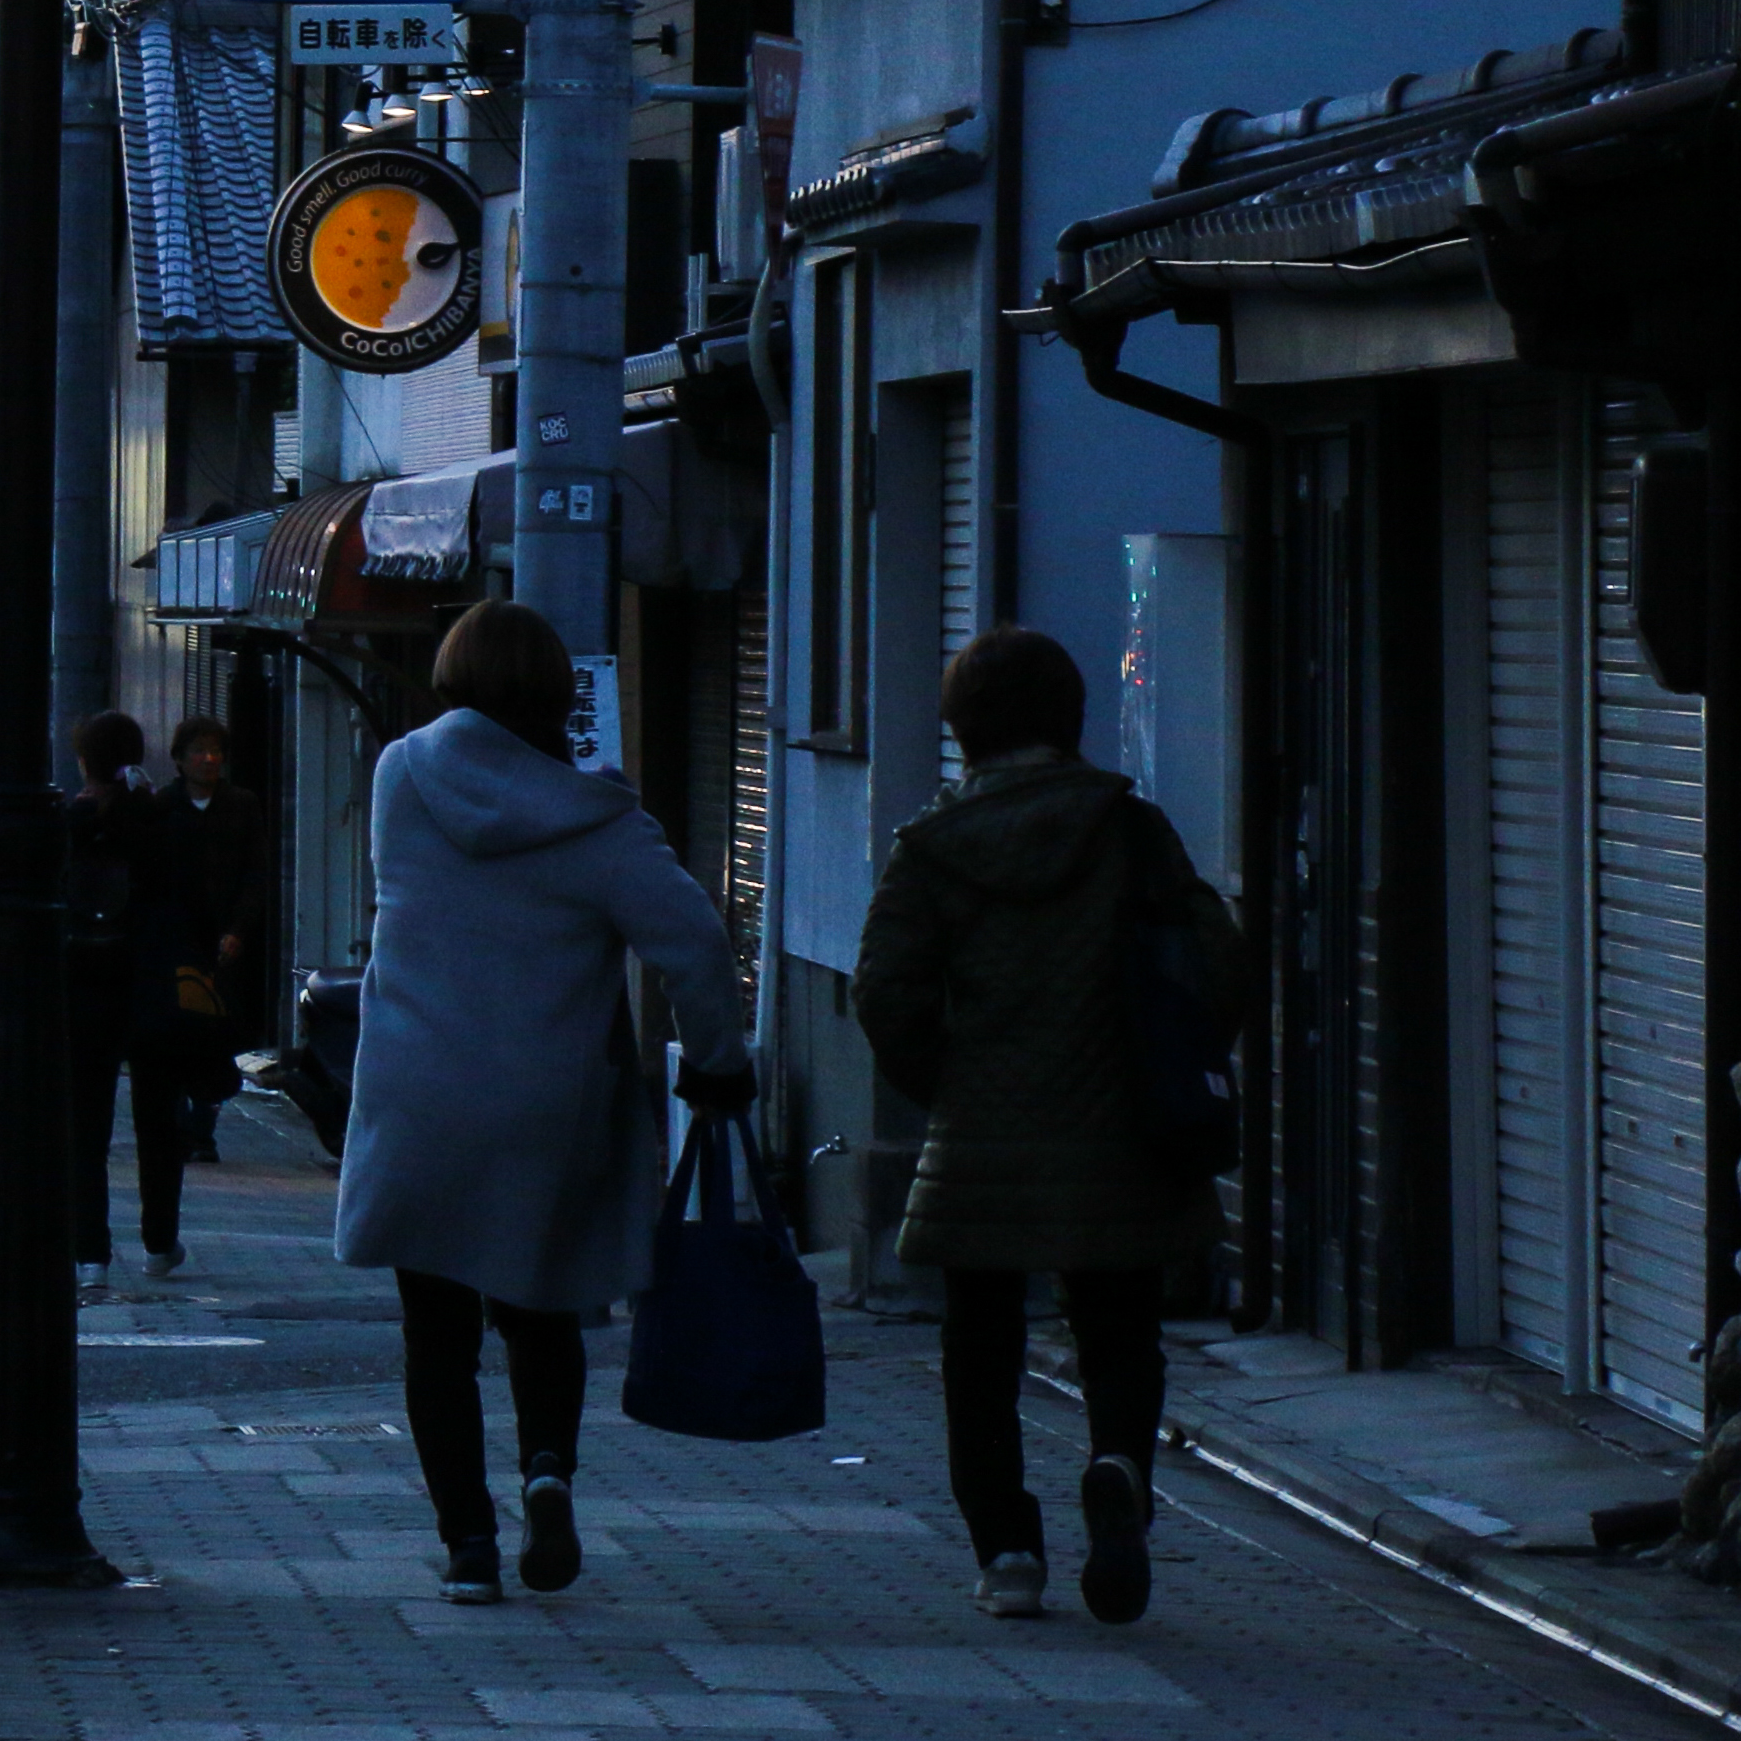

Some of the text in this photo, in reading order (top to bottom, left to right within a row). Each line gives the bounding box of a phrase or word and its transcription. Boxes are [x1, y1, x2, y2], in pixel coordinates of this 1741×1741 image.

[299, 17, 446, 50] 自転車を除く
[285, 160, 430, 274] Good smell. Good curry
[340, 246, 481, 357] CoCoICHIBANYA
